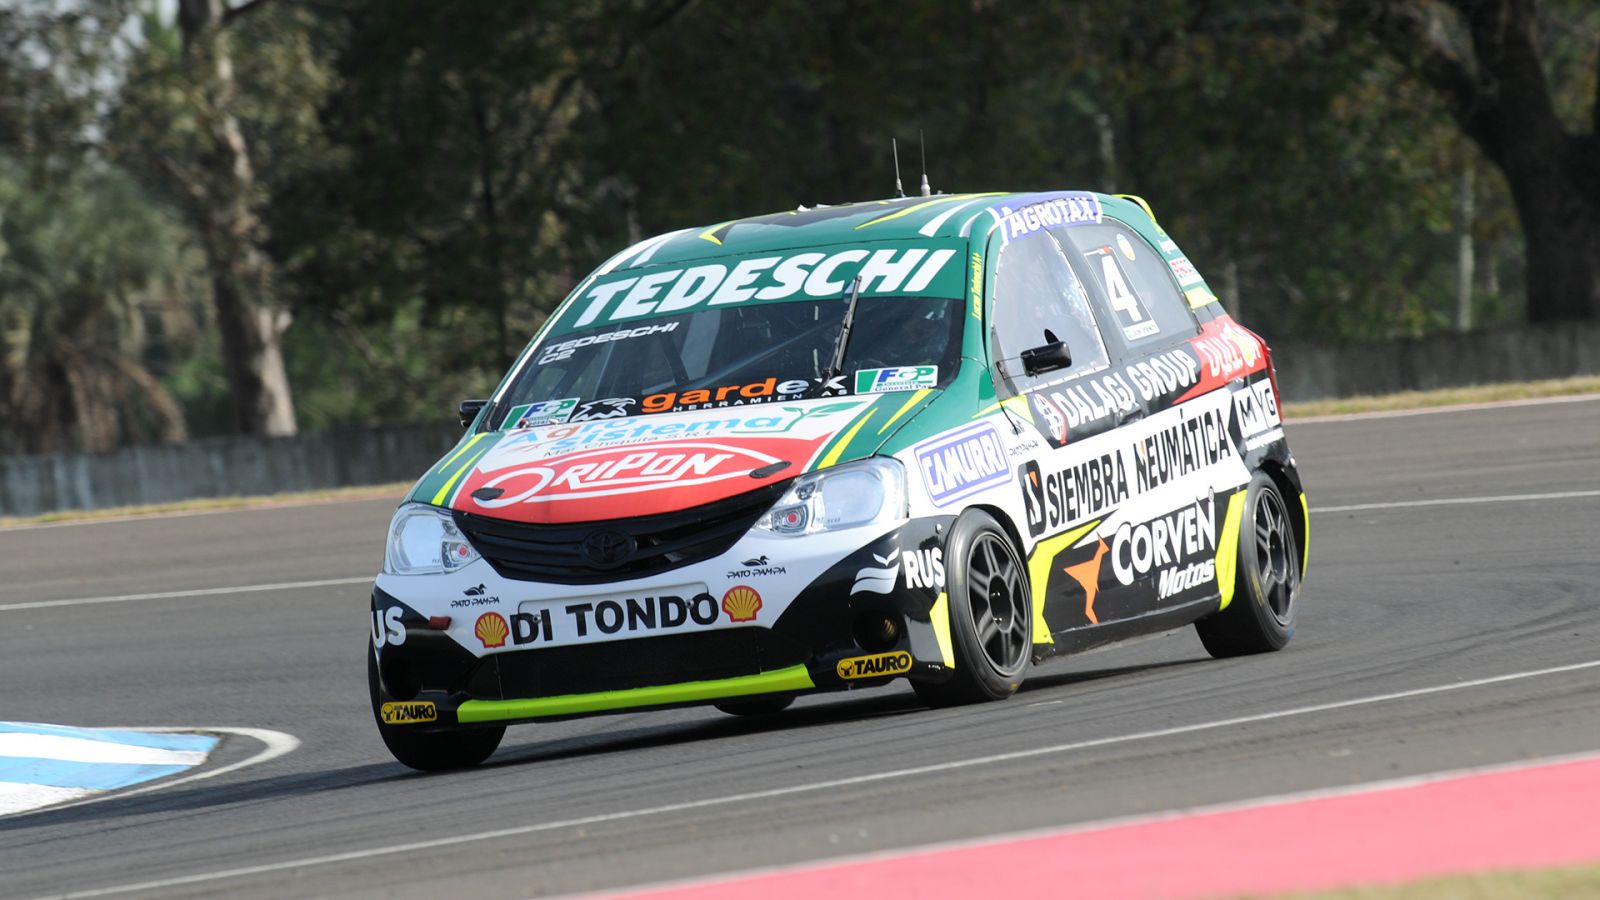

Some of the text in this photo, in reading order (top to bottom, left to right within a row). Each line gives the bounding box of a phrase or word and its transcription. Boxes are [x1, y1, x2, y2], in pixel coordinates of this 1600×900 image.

[1009, 197, 1096, 238] AGROTAX
[573, 249, 957, 328] TEDESCHI
[1101, 254, 1143, 322] 4
[538, 349, 576, 366] C2
[544, 321, 681, 356] TEDESCHI
[640, 375, 848, 413] gardex
[672, 389, 848, 412] HERRAMIENAS
[1051, 349, 1198, 428] DALAGI GROUP
[922, 431, 1008, 496] CAMURRI
[1046, 408, 1231, 529] SIEMBRA NEUMÁTICA
[1111, 498, 1216, 587] CORVEN
[726, 566, 787, 580] PATO PAMPA
[902, 546, 946, 590] RUS
[1159, 558, 1216, 600] Motos
[450, 595, 501, 609] PATO PAMPA
[509, 592, 719, 647] DI TONDO
[371, 606, 407, 649] US
[854, 652, 910, 676] TAURO
[393, 704, 436, 721] TAURO
